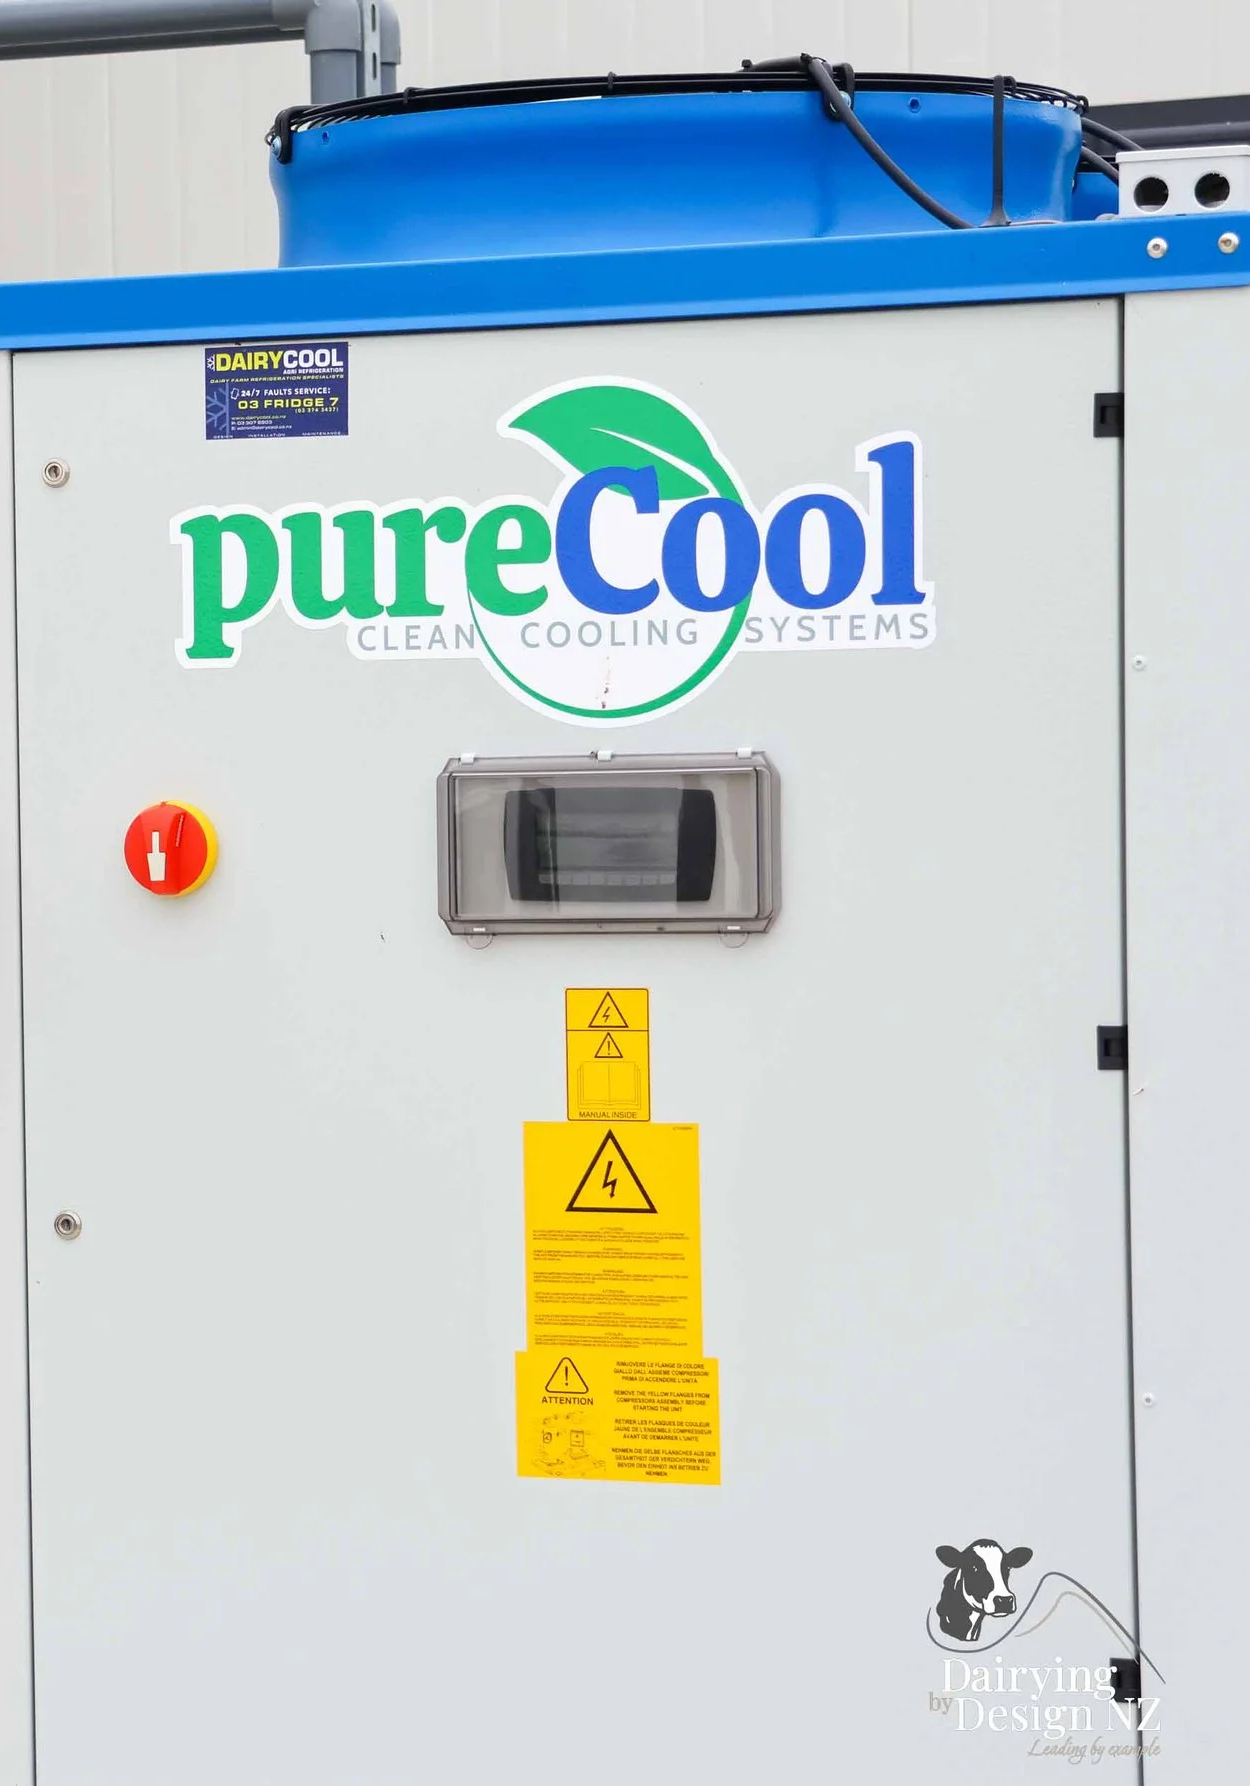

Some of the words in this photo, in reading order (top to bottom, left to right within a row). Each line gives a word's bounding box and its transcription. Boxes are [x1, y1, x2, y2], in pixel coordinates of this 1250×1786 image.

[216, 348, 343, 371] DAIRYCOOL
[241, 389, 260, 397] 24/7
[294, 387, 331, 395] SERVICE:
[238, 400, 259, 410] 03
[264, 398, 324, 409] FRIDGE
[330, 397, 339, 407] 7
[179, 439, 926, 660] pureCool
[357, 624, 477, 653] CLEAN
[520, 618, 700, 650] COOLING
[743, 612, 930, 644] SYSTEMS
[612, 1111, 638, 1119] INSIDE
[541, 1396, 594, 1406] ATTENTION
